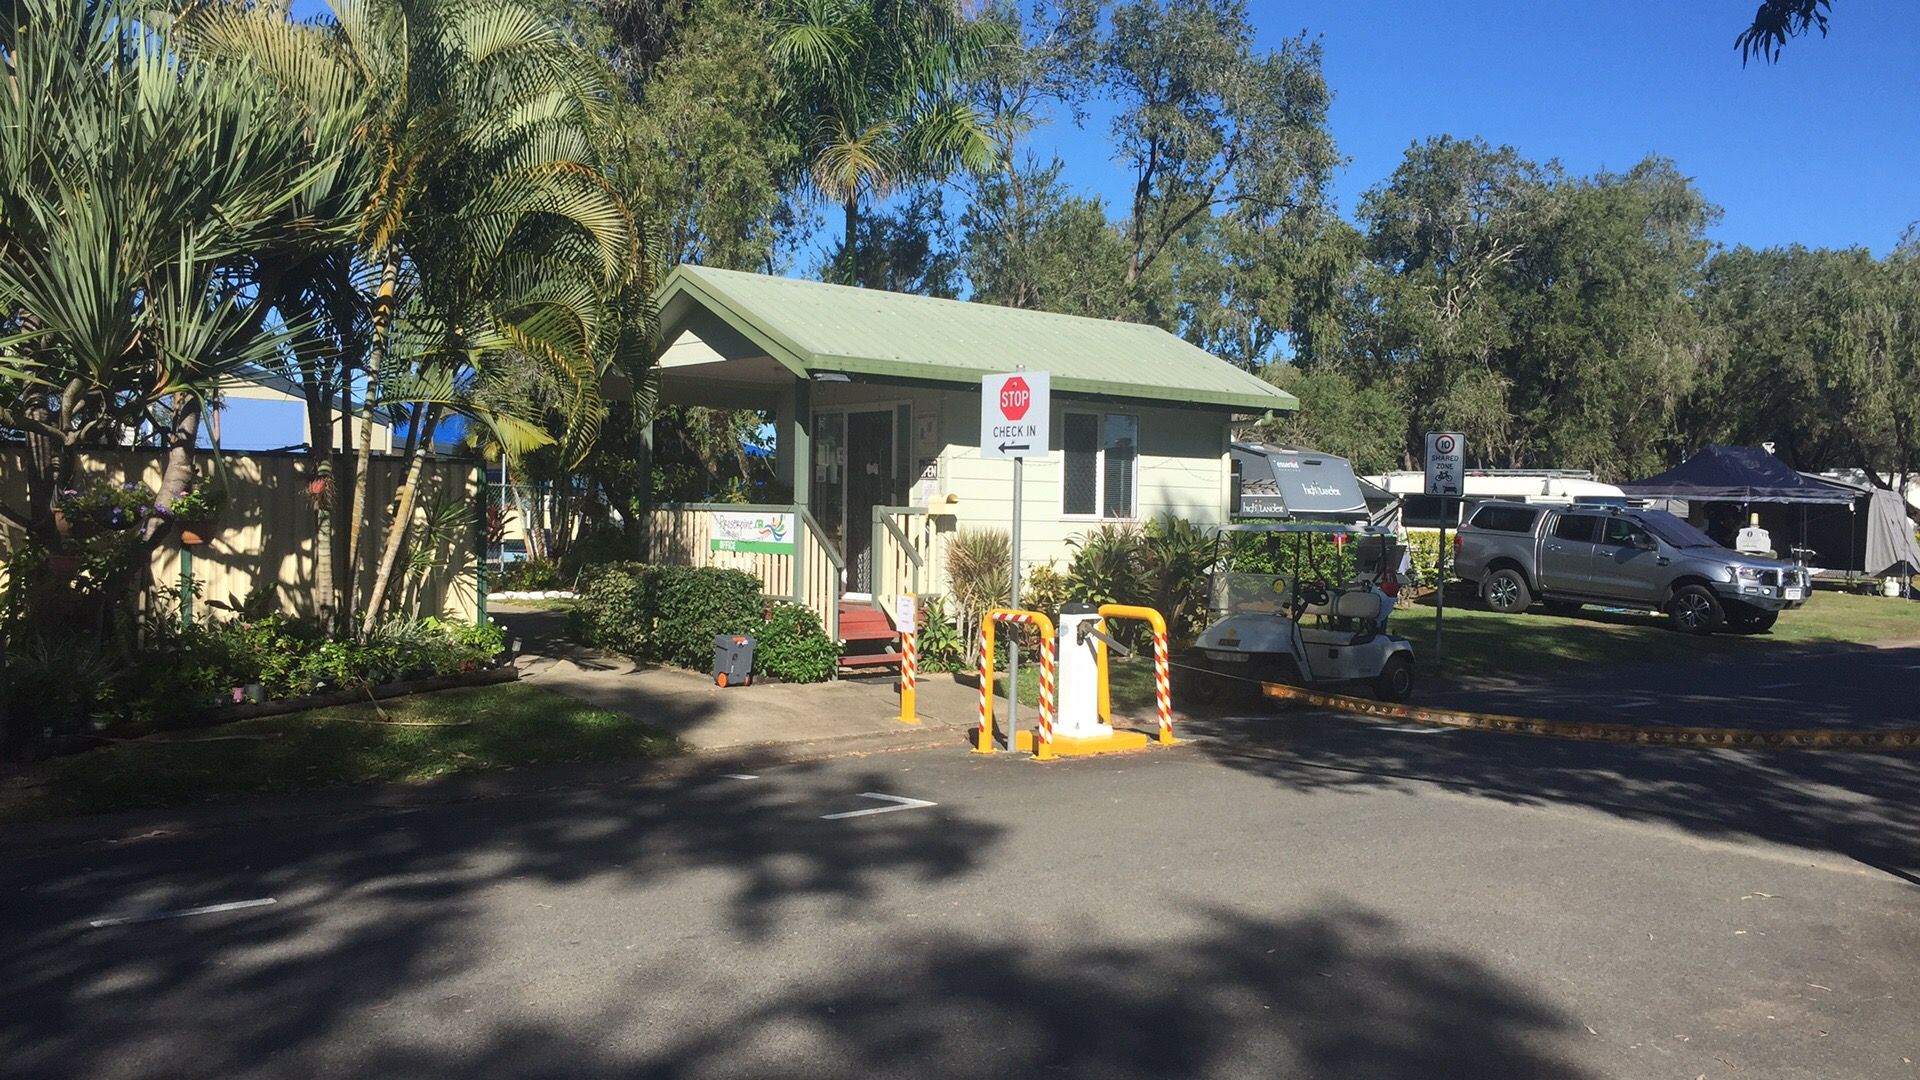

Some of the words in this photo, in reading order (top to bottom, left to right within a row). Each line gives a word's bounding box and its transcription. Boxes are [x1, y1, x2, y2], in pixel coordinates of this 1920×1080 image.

[1002, 391, 1028, 407] STOP
[993, 426, 1023, 438] CHECK
[1026, 425, 1036, 437] IN
[1440, 440, 1451, 449] 10
[1431, 454, 1459, 462] SHARED
[719, 540, 736, 550] OFFICE
